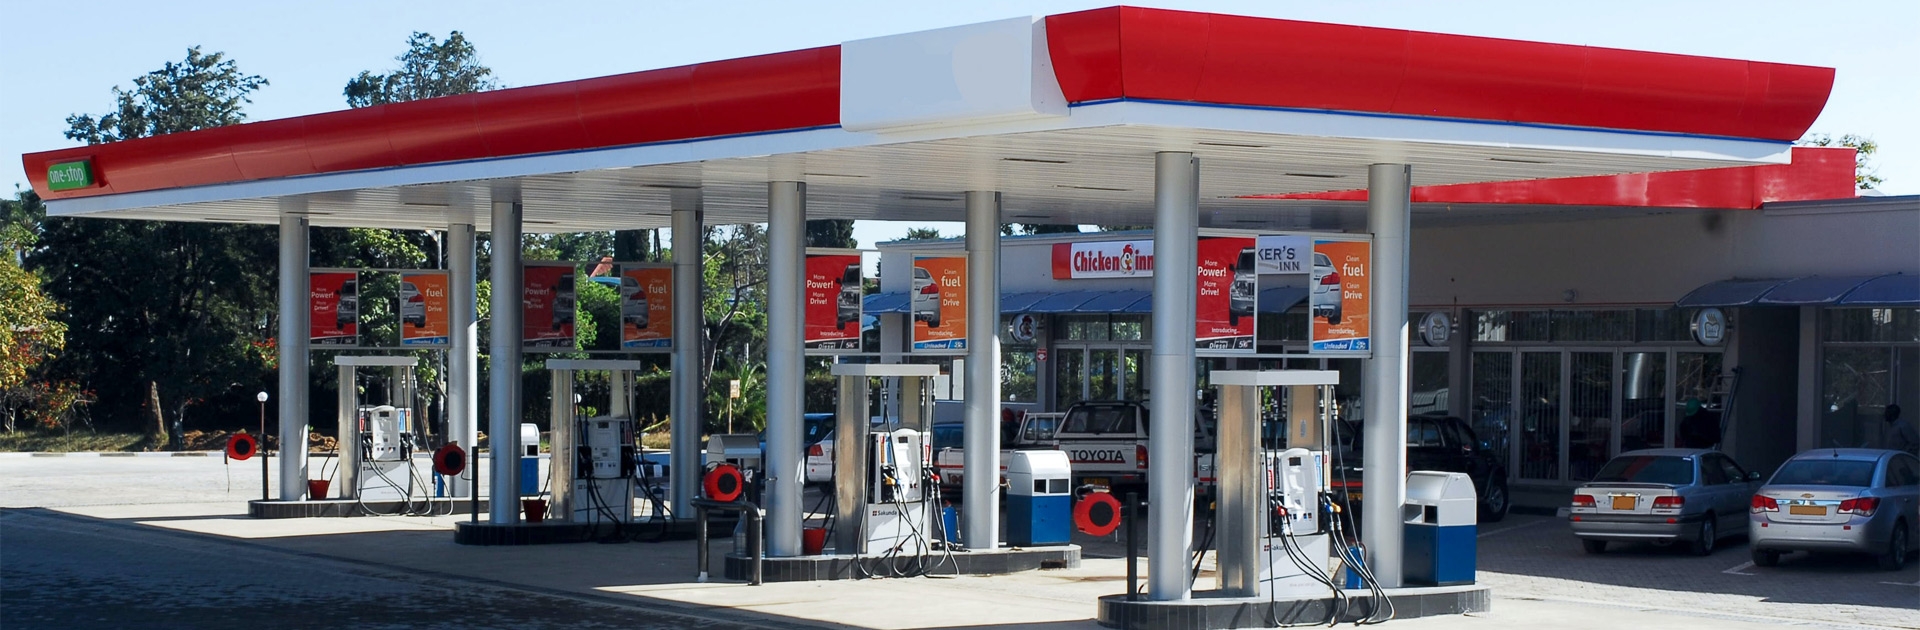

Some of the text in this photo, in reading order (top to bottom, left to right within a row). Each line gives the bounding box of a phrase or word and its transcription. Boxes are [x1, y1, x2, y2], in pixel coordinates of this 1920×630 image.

[50, 166, 84, 186] one-stop
[1074, 250, 1154, 271] Chicken inn
[1198, 266, 1226, 276] Power!
[1279, 262, 1300, 270] INN
[1343, 264, 1364, 276] fuel
[806, 280, 834, 288] Power!
[941, 276, 961, 286] fuel
[426, 288, 444, 296] fuel
[648, 284, 667, 294] fuel
[1200, 288, 1220, 296] Drive!
[1344, 290, 1362, 299] Drive
[1324, 342, 1348, 350] Unleaded
[1070, 450, 1124, 460] TOYOTA
